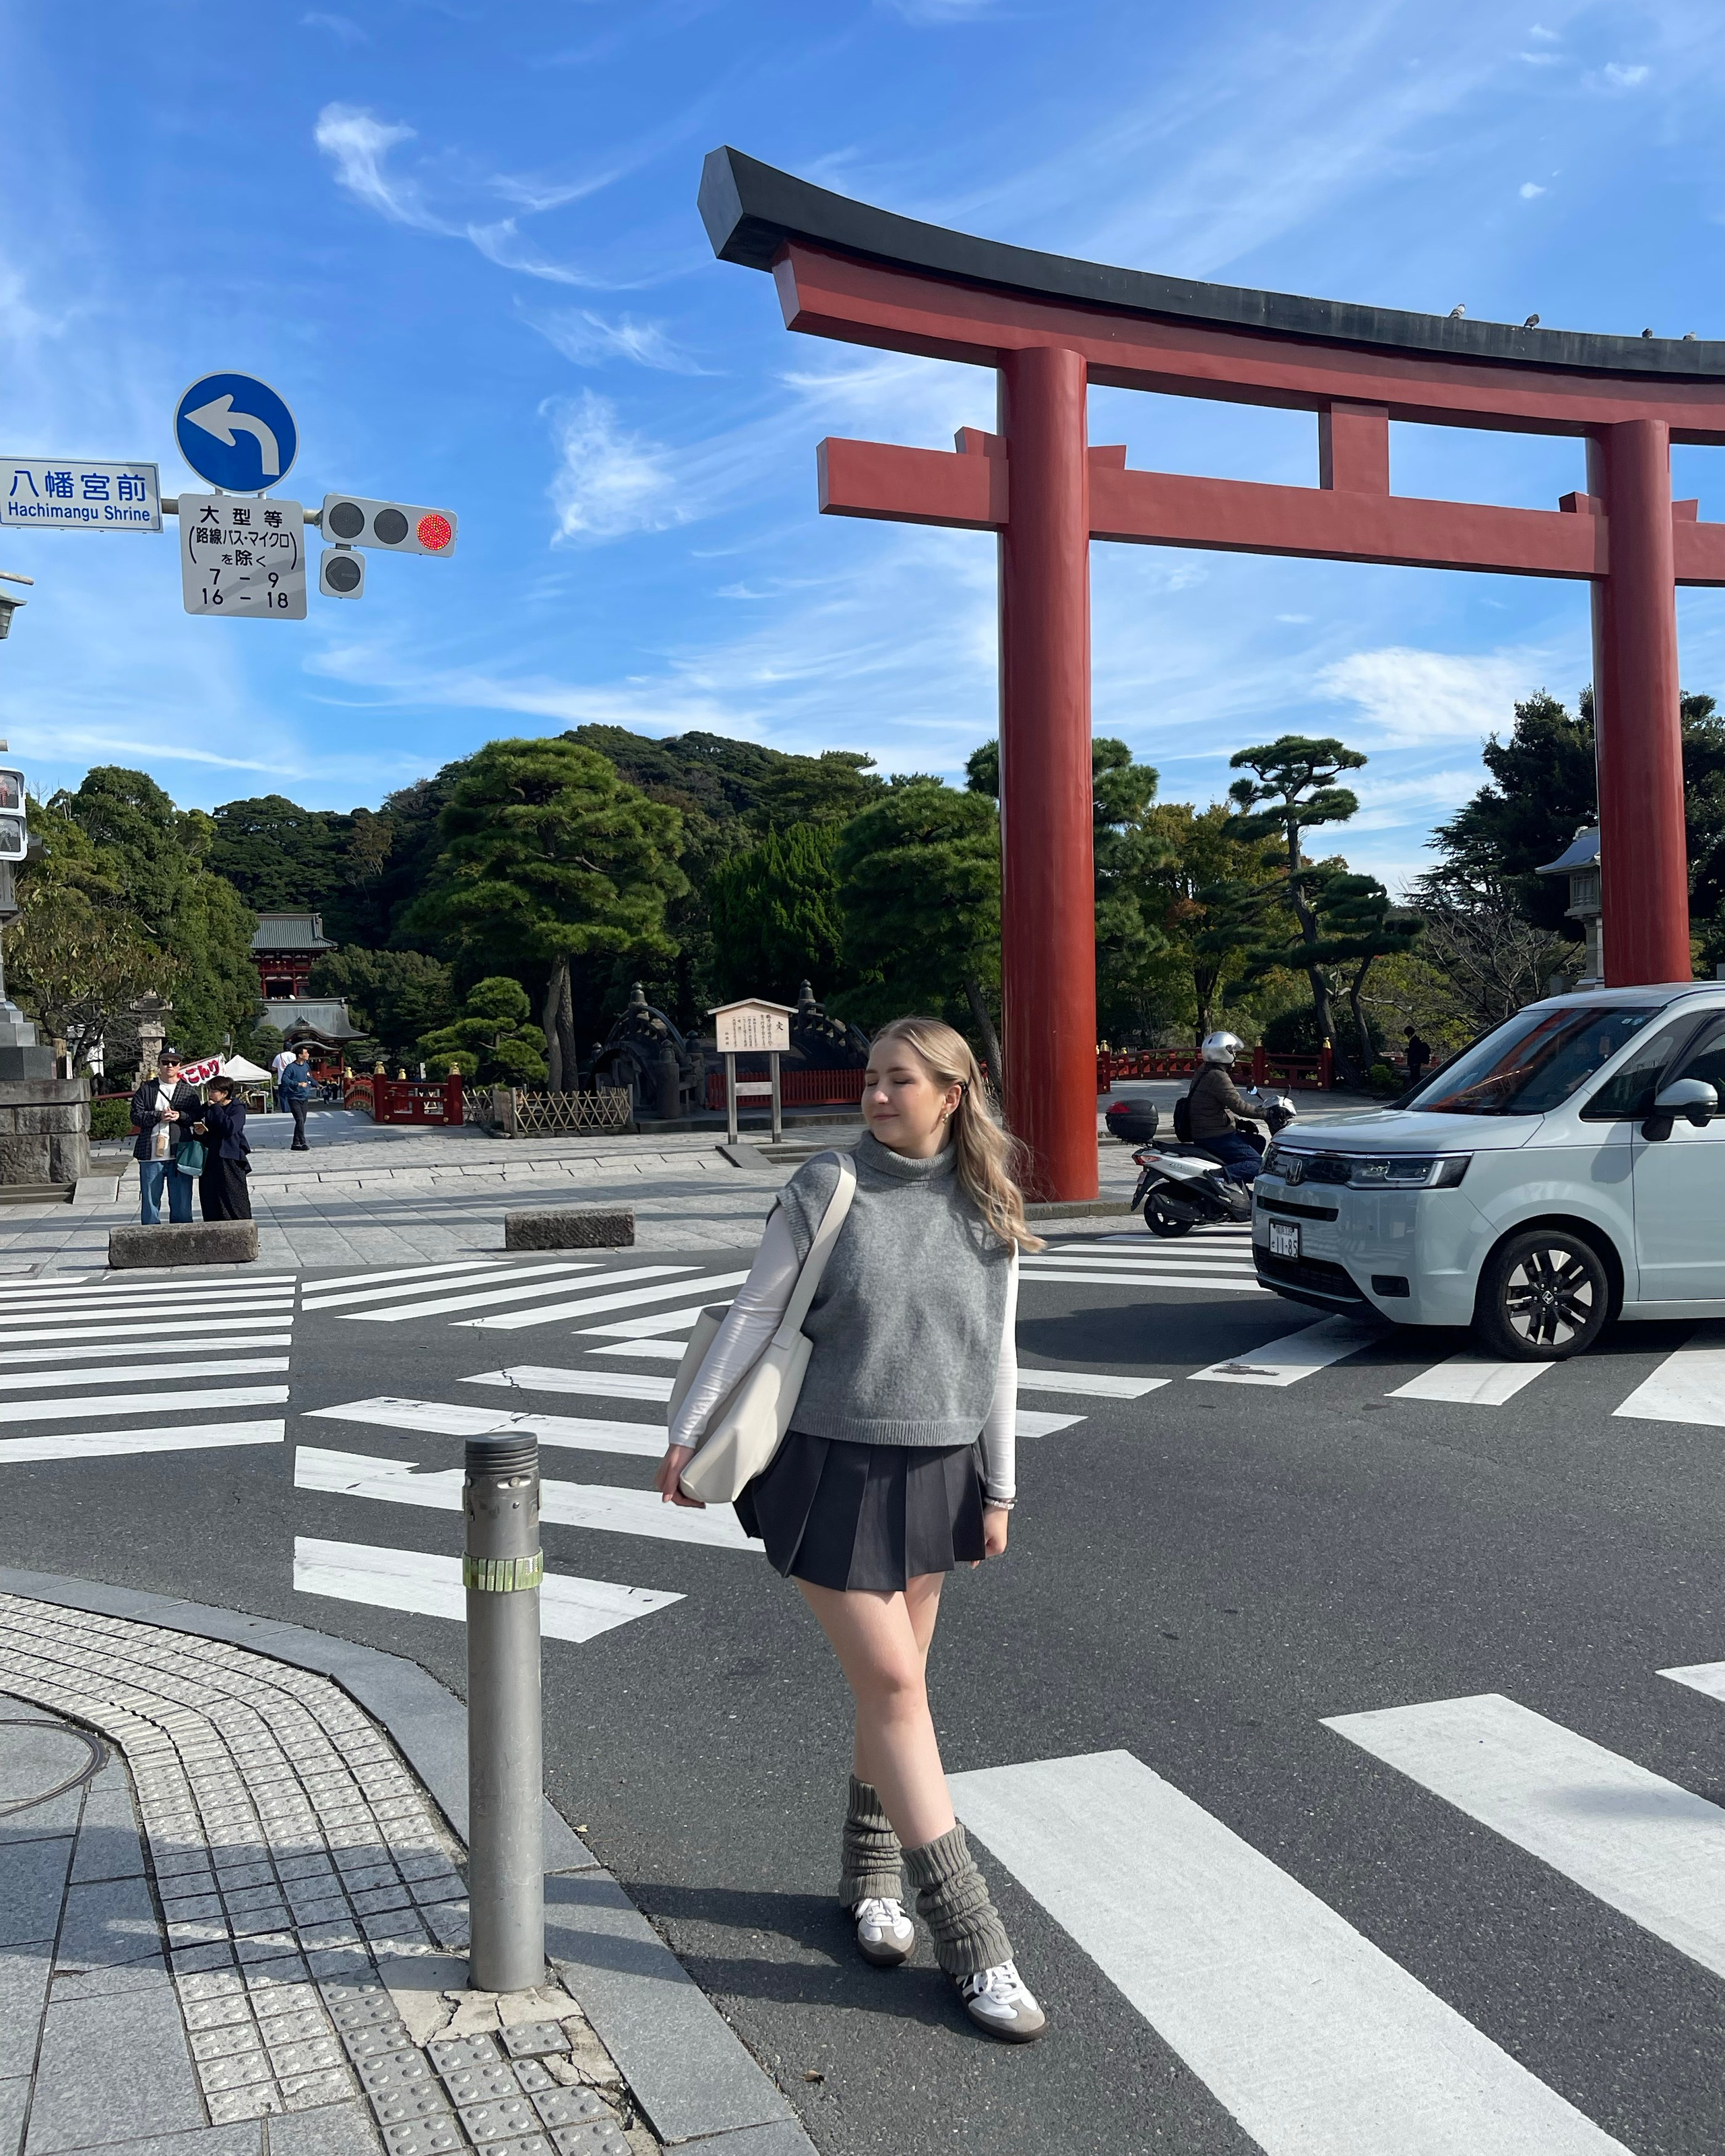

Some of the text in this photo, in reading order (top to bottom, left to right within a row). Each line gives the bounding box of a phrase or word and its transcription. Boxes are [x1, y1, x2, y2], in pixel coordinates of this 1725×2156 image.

[9, 470, 146, 502] 八幡宮前
[8, 501, 151, 521] Hachimangu Shrine
[202, 588, 224, 605] 16
[268, 592, 289, 608] 18
